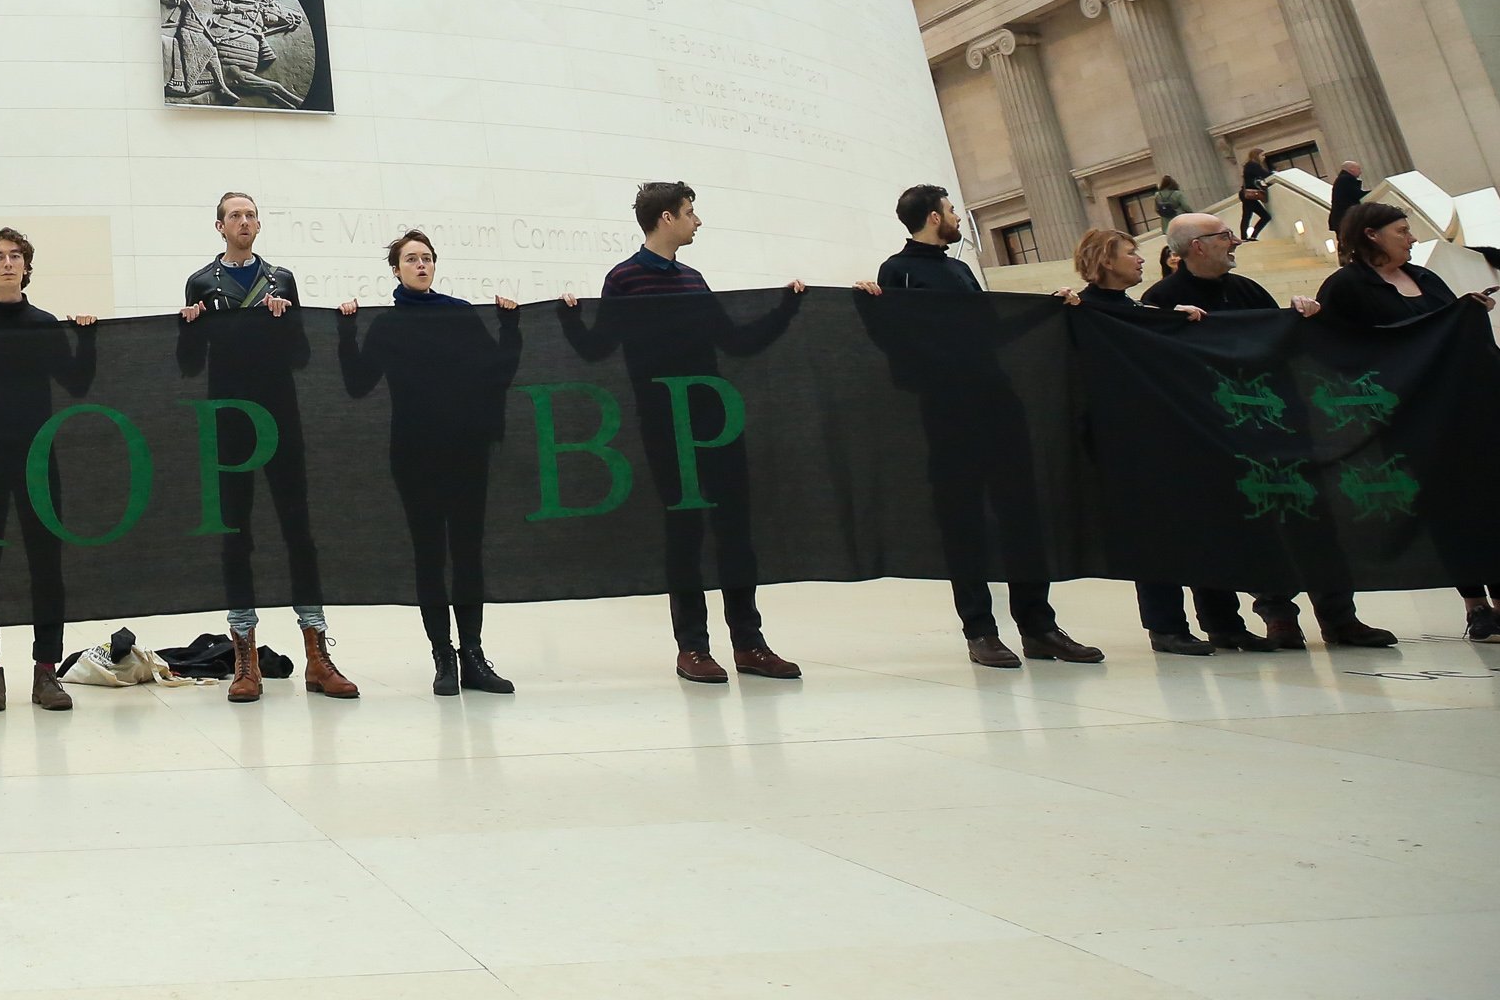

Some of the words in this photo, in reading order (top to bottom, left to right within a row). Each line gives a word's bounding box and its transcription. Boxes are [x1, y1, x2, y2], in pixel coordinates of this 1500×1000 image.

[268, 210, 325, 244] The
[513, 217, 645, 254] Commissio
[440, 272, 522, 304] ottery
[507, 375, 746, 522] BP
